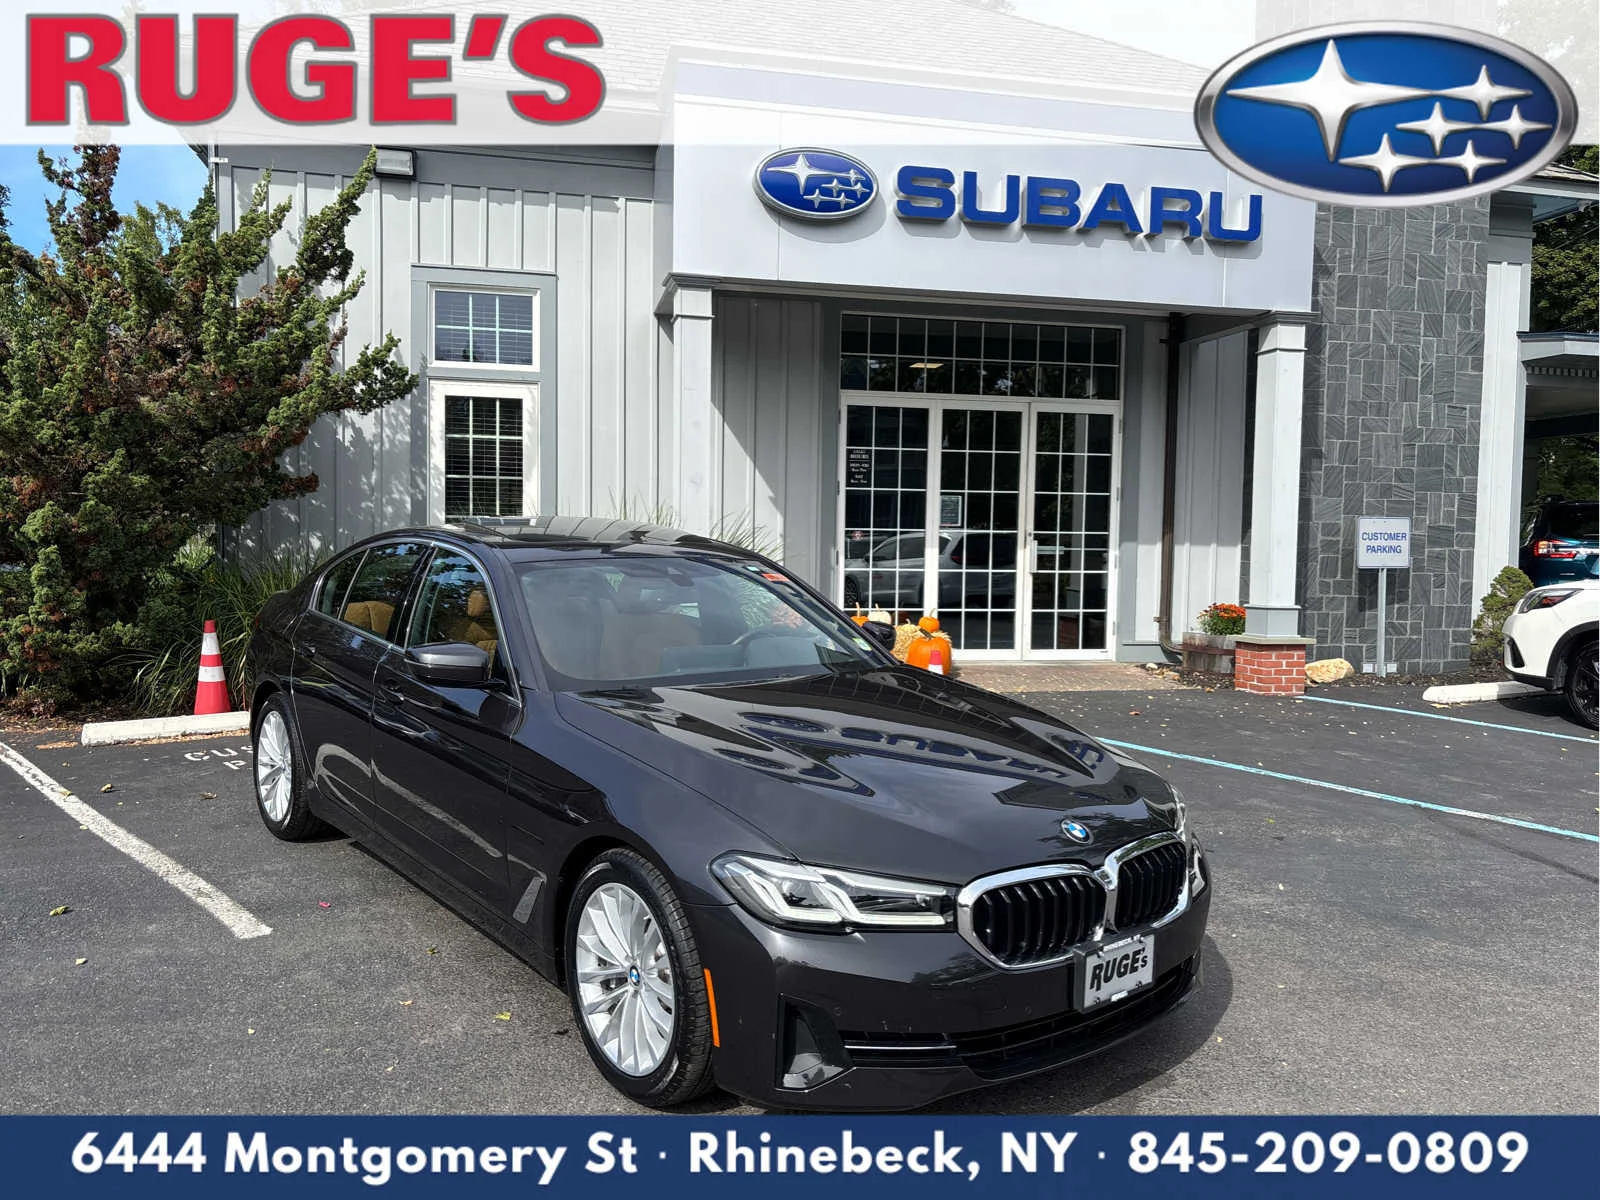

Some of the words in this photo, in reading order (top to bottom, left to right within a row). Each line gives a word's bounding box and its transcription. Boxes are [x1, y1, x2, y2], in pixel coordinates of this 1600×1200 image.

[896, 164, 1264, 242] SUBARU
[1361, 532, 1407, 542] CUSTOMER
[1366, 545, 1402, 554] PARKING
